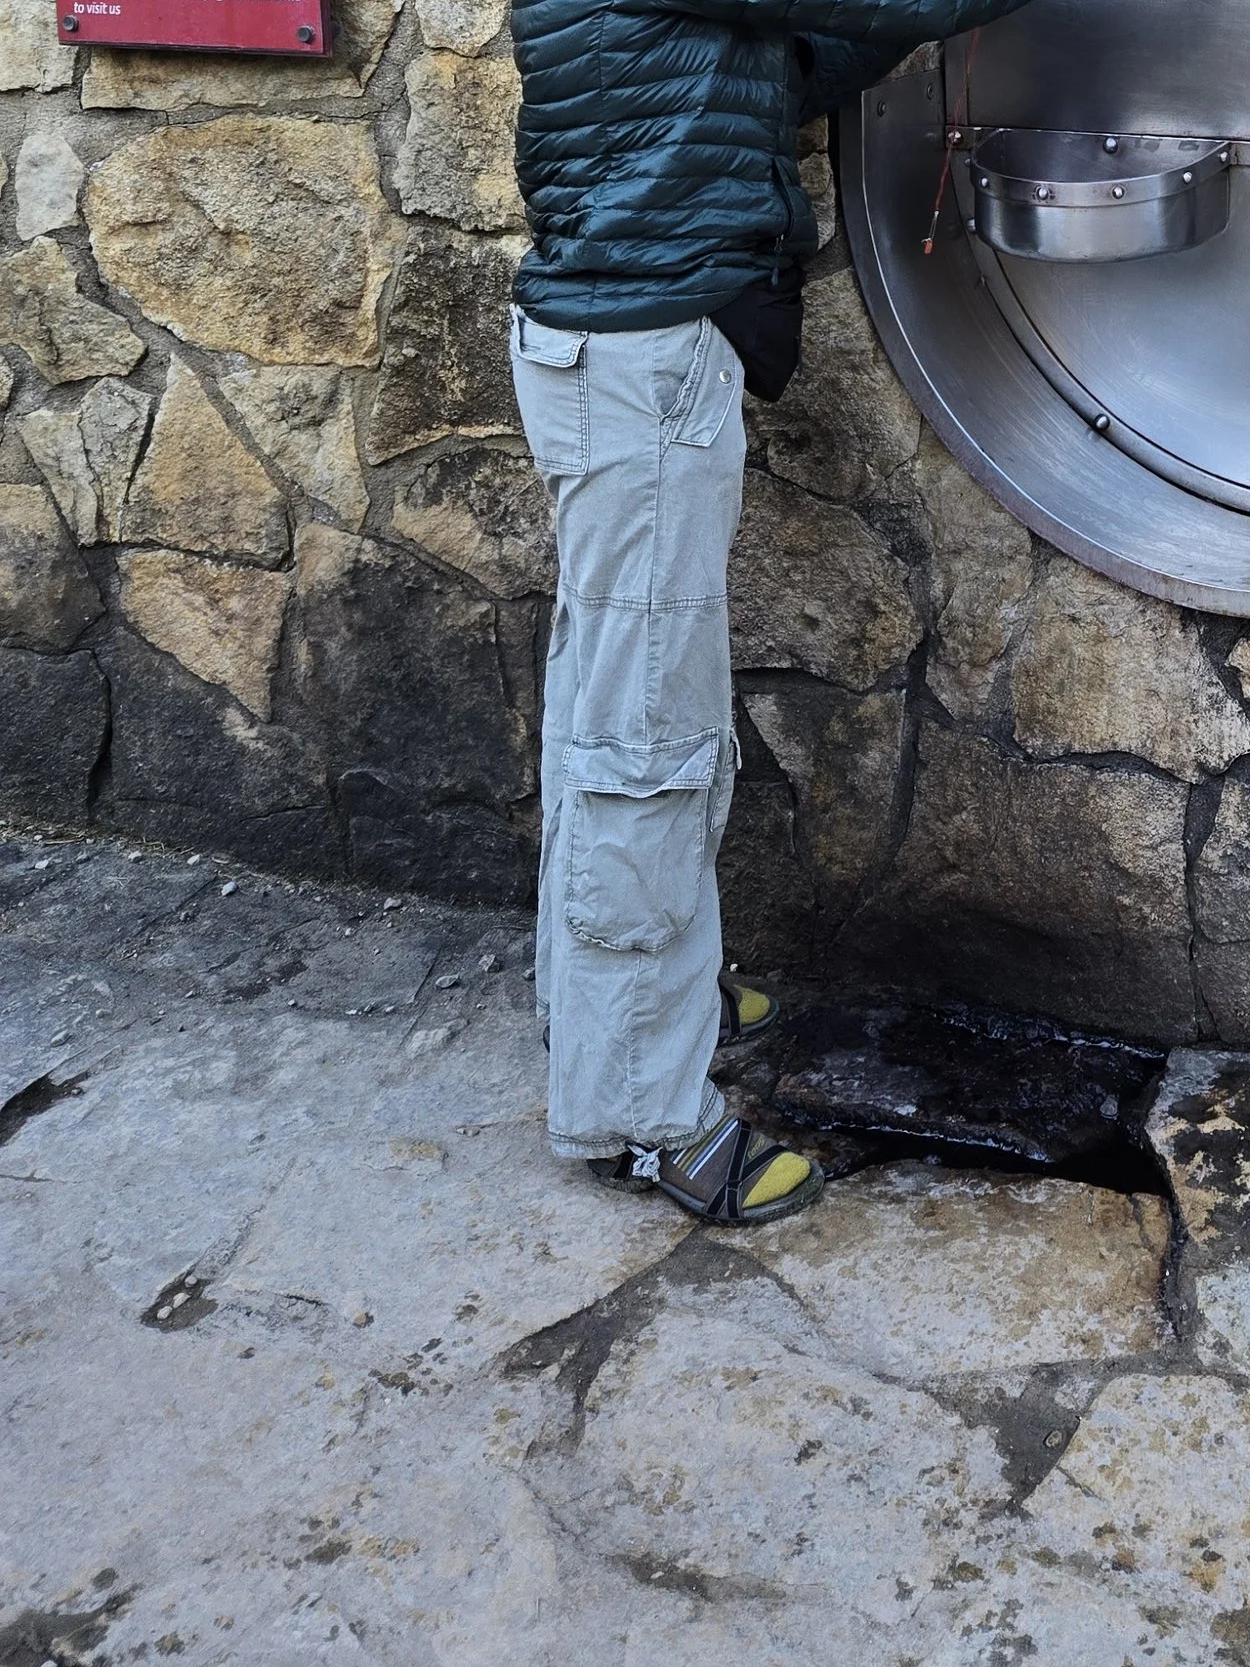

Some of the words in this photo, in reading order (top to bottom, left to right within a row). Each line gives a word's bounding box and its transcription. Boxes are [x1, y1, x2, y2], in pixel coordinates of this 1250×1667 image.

[73, 2, 85, 14] to
[86, 2, 108, 15] visit
[109, 5, 121, 16] us
